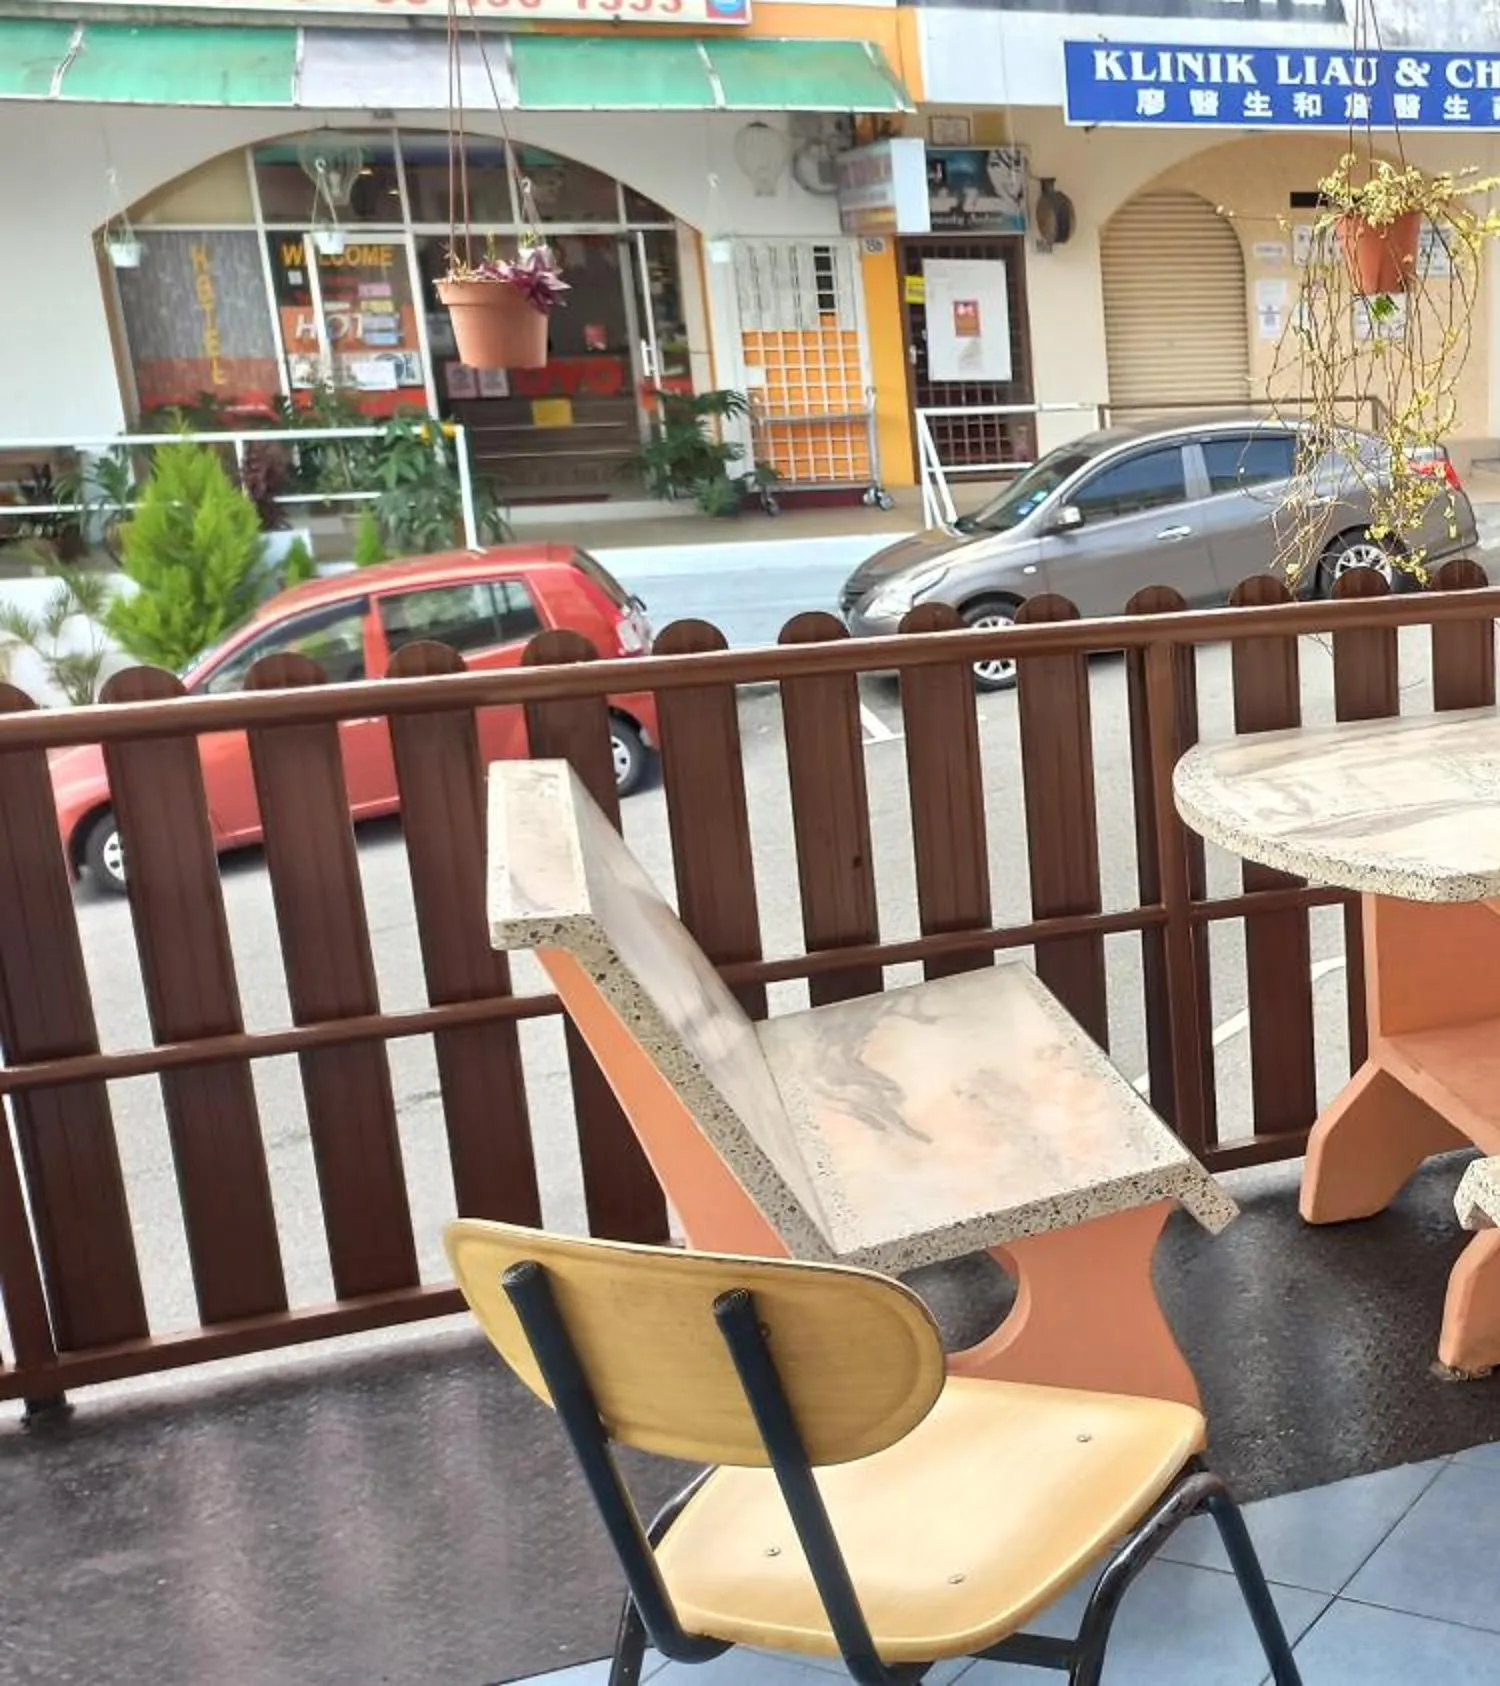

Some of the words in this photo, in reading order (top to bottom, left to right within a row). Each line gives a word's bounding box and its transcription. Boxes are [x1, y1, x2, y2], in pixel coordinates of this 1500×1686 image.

[1094, 50, 1258, 85] KLINIK
[1276, 54, 1378, 86] LIAU
[1395, 58, 1431, 88] &
[281, 243, 396, 267] WCOME
